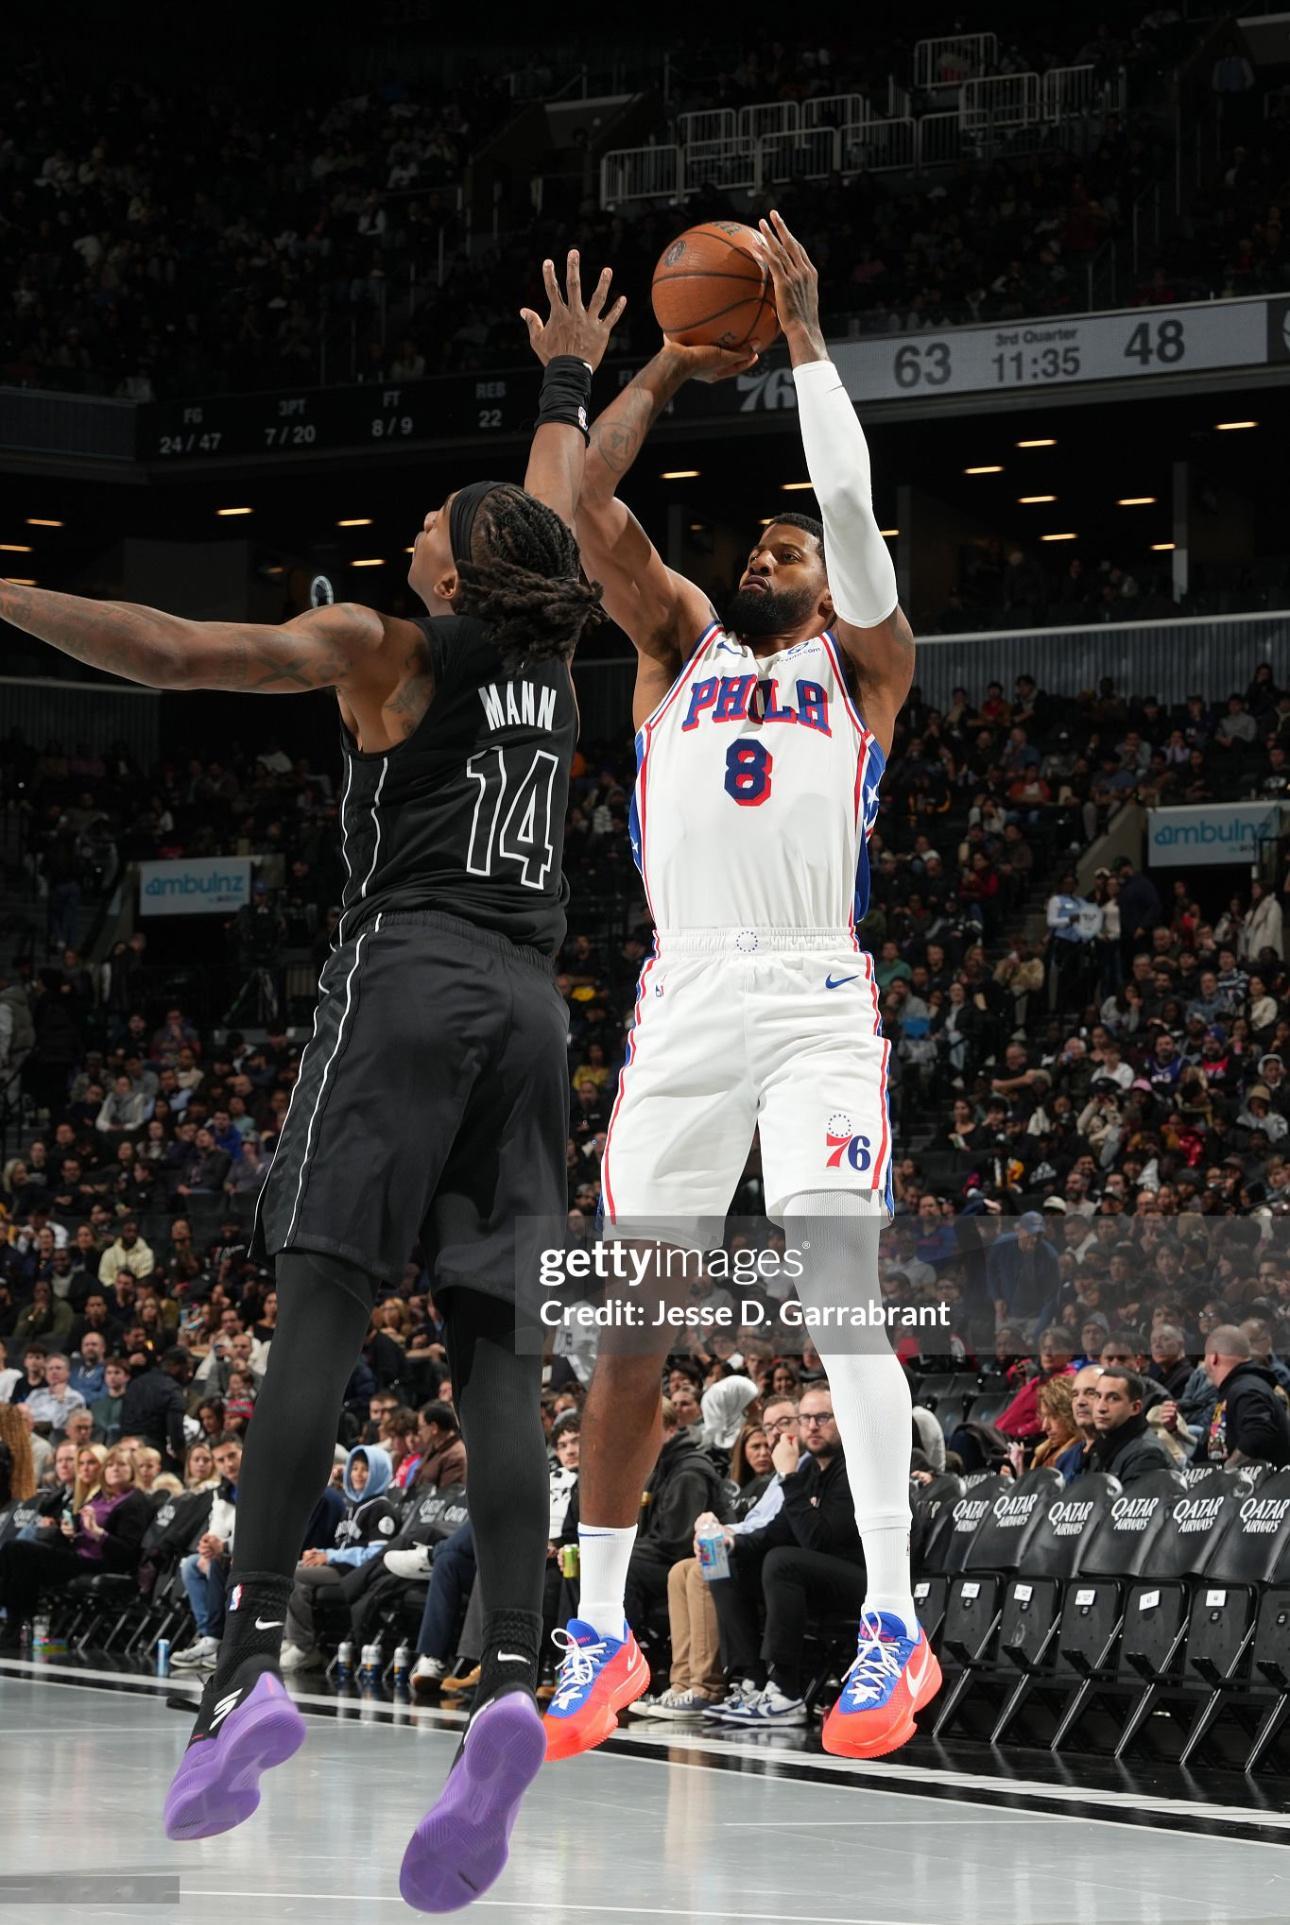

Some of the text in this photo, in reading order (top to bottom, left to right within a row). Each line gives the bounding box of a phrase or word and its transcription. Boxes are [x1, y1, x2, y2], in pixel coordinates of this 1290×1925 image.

[995, 328, 1078, 347] 3rd Quarter
[1123, 319, 1186, 366] 48
[894, 341, 951, 388] 63
[991, 346, 1081, 383] 11:35
[383, 391, 401, 407] FT
[475, 381, 506, 399] REB
[184, 408, 203, 424] FG
[279, 398, 306, 416] 3PT
[478, 409, 501, 428] 22
[478, 680, 557, 731] MANN
[681, 673, 833, 739] PHILA
[724, 738, 773, 807] 8
[466, 745, 559, 890] 14
[145, 870, 243, 895] ambulnz
[826, 1133, 871, 1172] 76
[993, 1493, 1038, 1519] QATAR
[1048, 1501, 1094, 1526] QATAR
[1111, 1497, 1159, 1521] QATAR
[1173, 1496, 1225, 1523] QATAR
[1239, 1498, 1290, 1523] QATAR
[1178, 1517, 1216, 1533] AIRWAYS
